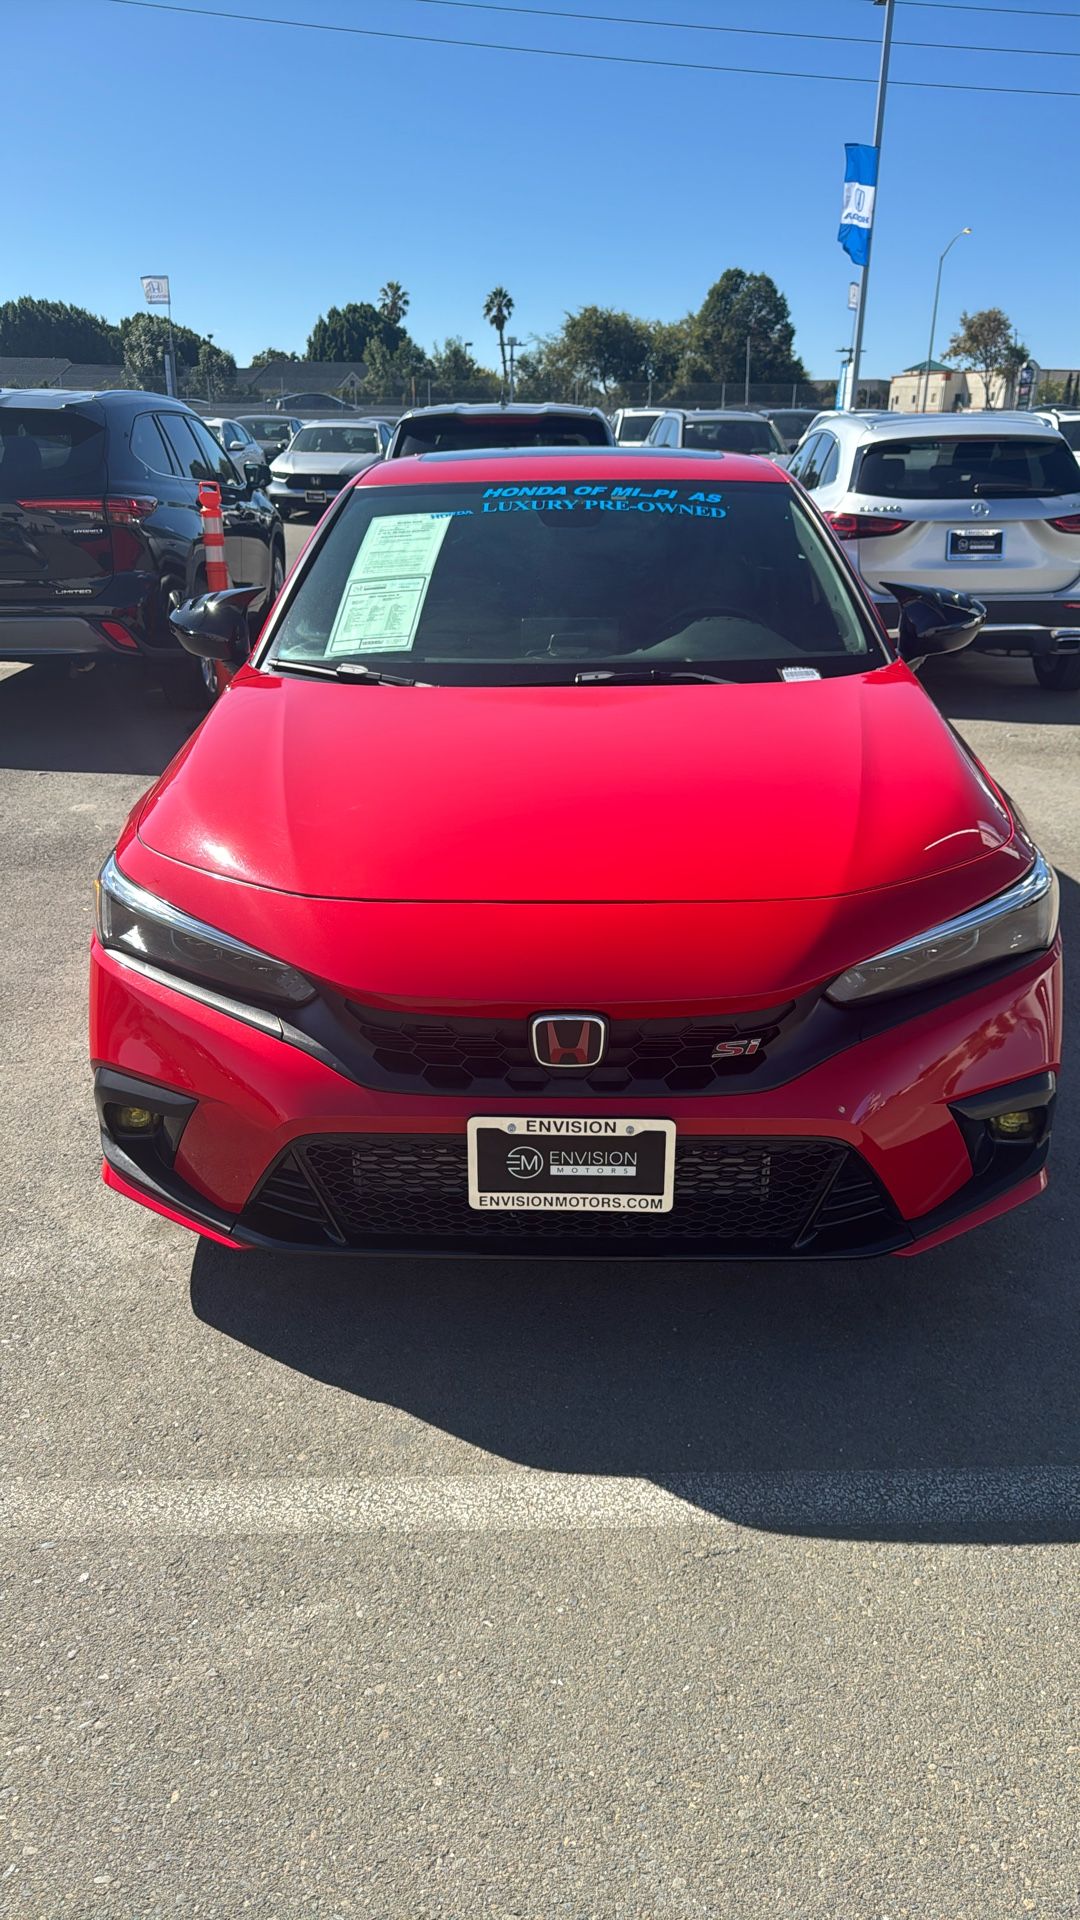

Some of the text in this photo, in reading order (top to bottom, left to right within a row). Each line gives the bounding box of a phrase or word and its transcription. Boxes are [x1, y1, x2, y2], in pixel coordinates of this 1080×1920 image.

[482, 486, 722, 503] HONDA OF MIPIAS
[482, 499, 727, 519] LUXURY PRE-OWNED
[711, 1038, 762, 1058] Si
[526, 1119, 617, 1134] ENVISION
[549, 1151, 638, 1165] ENVISION
[479, 1195, 664, 1210] ENVISIONMOTORS.COM
